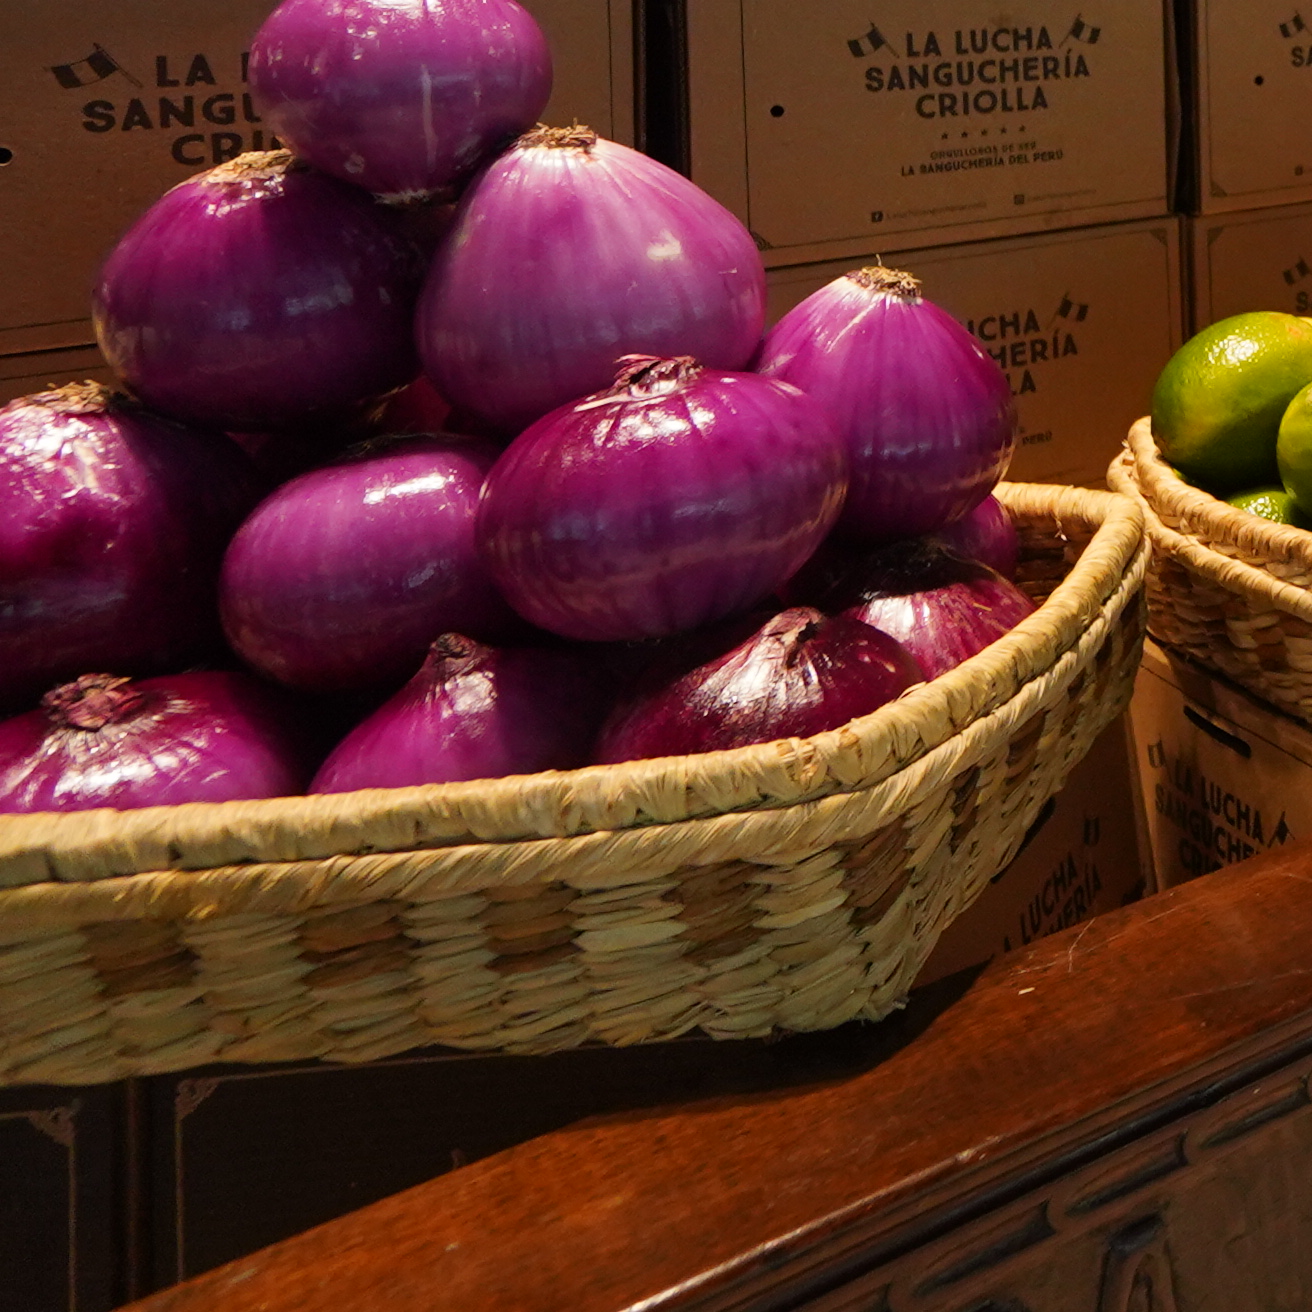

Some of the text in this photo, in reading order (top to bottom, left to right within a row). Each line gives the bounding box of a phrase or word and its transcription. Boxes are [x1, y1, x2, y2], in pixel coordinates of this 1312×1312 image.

[906, 26, 1052, 57] LA LUCHA
[156, 53, 217, 87] LA
[864, 49, 1090, 92] SANGUCHERÍA
[915, 86, 1048, 119] CRIOLLA
[901, 166, 915, 176] LA
[1008, 153, 1029, 165] DEL
[961, 308, 1041, 340] CHA
[1155, 783, 1257, 860] SANGUCHE
[1200, 775, 1264, 844] LUCHA
[1020, 852, 1077, 945] LUCHA
